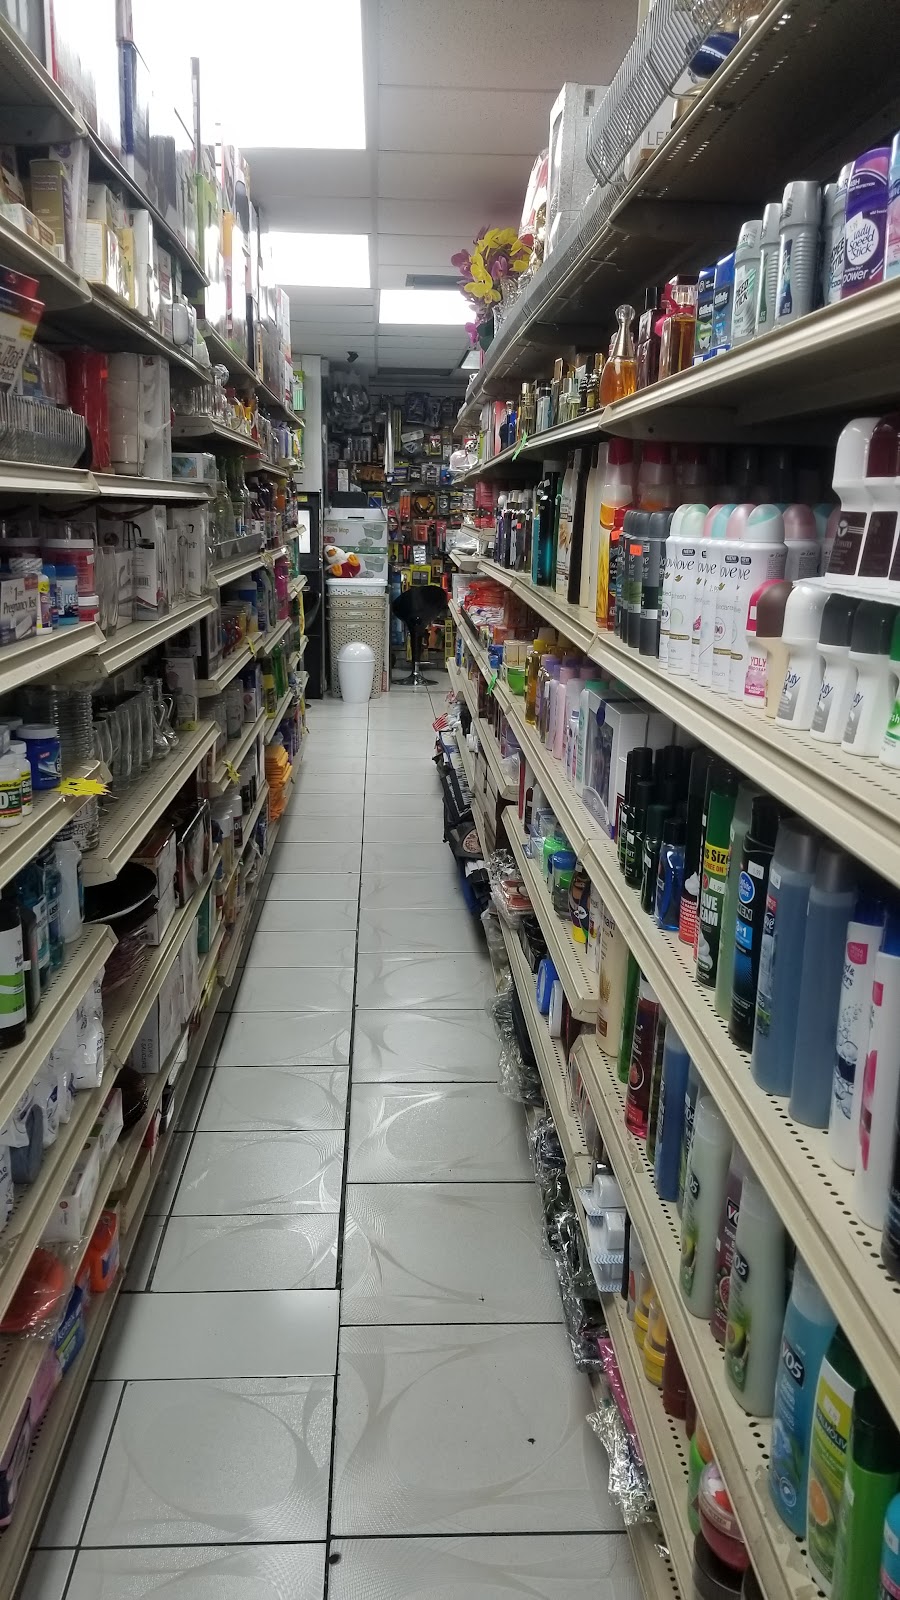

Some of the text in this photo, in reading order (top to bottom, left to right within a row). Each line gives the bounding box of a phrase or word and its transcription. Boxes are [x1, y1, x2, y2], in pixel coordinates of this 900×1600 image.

[842, 269, 869, 287] power
[3, 600, 28, 617] Pregnancy
[701, 892, 718, 912] AVE
[701, 908, 719, 927] EAM
